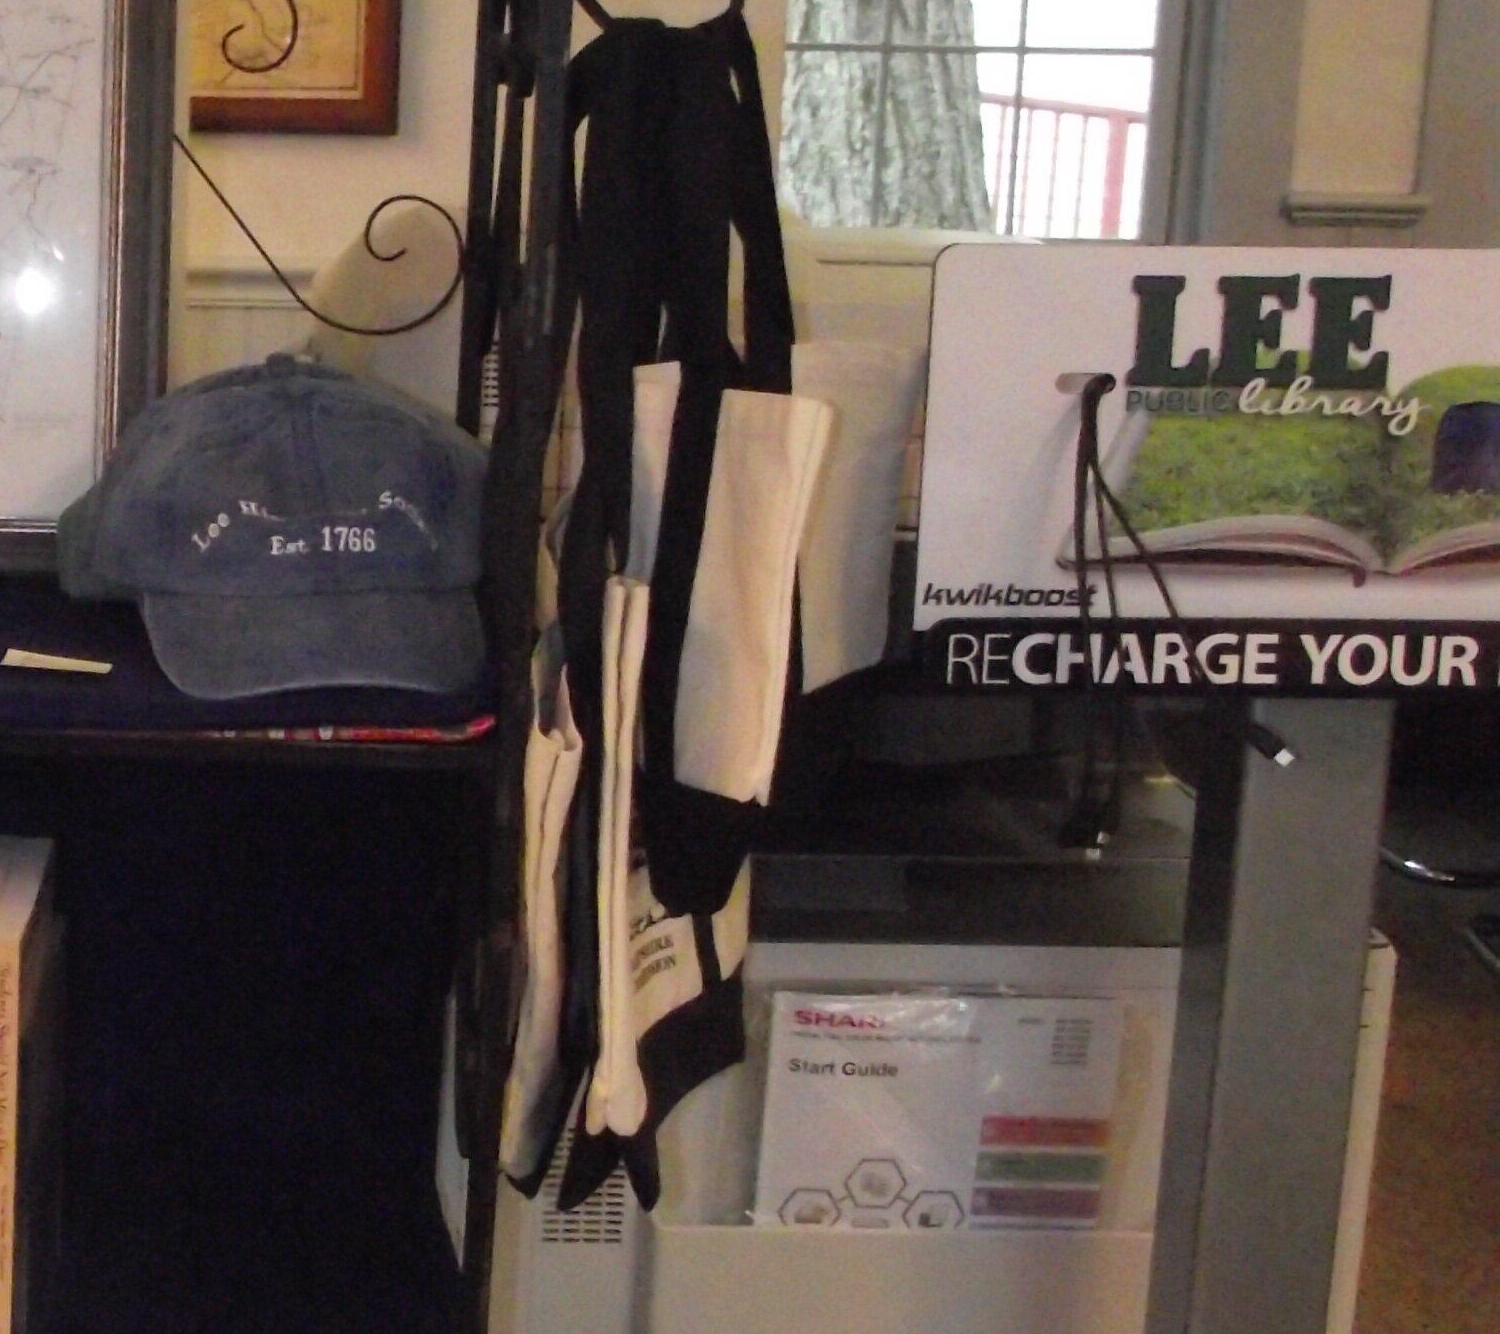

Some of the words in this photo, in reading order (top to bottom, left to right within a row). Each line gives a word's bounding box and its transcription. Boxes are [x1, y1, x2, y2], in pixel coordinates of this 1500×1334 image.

[1125, 273, 1393, 387] LEE
[1126, 391, 1232, 413] PUBLIC
[1238, 374, 1430, 436] library
[321, 526, 377, 552] 1766
[922, 582, 1098, 607] kwikboost
[946, 632, 1280, 685] RECHARGE
[1299, 634, 1480, 686] YOUR
[789, 1058, 835, 1075] Start
[841, 1061, 899, 1076] Guide
